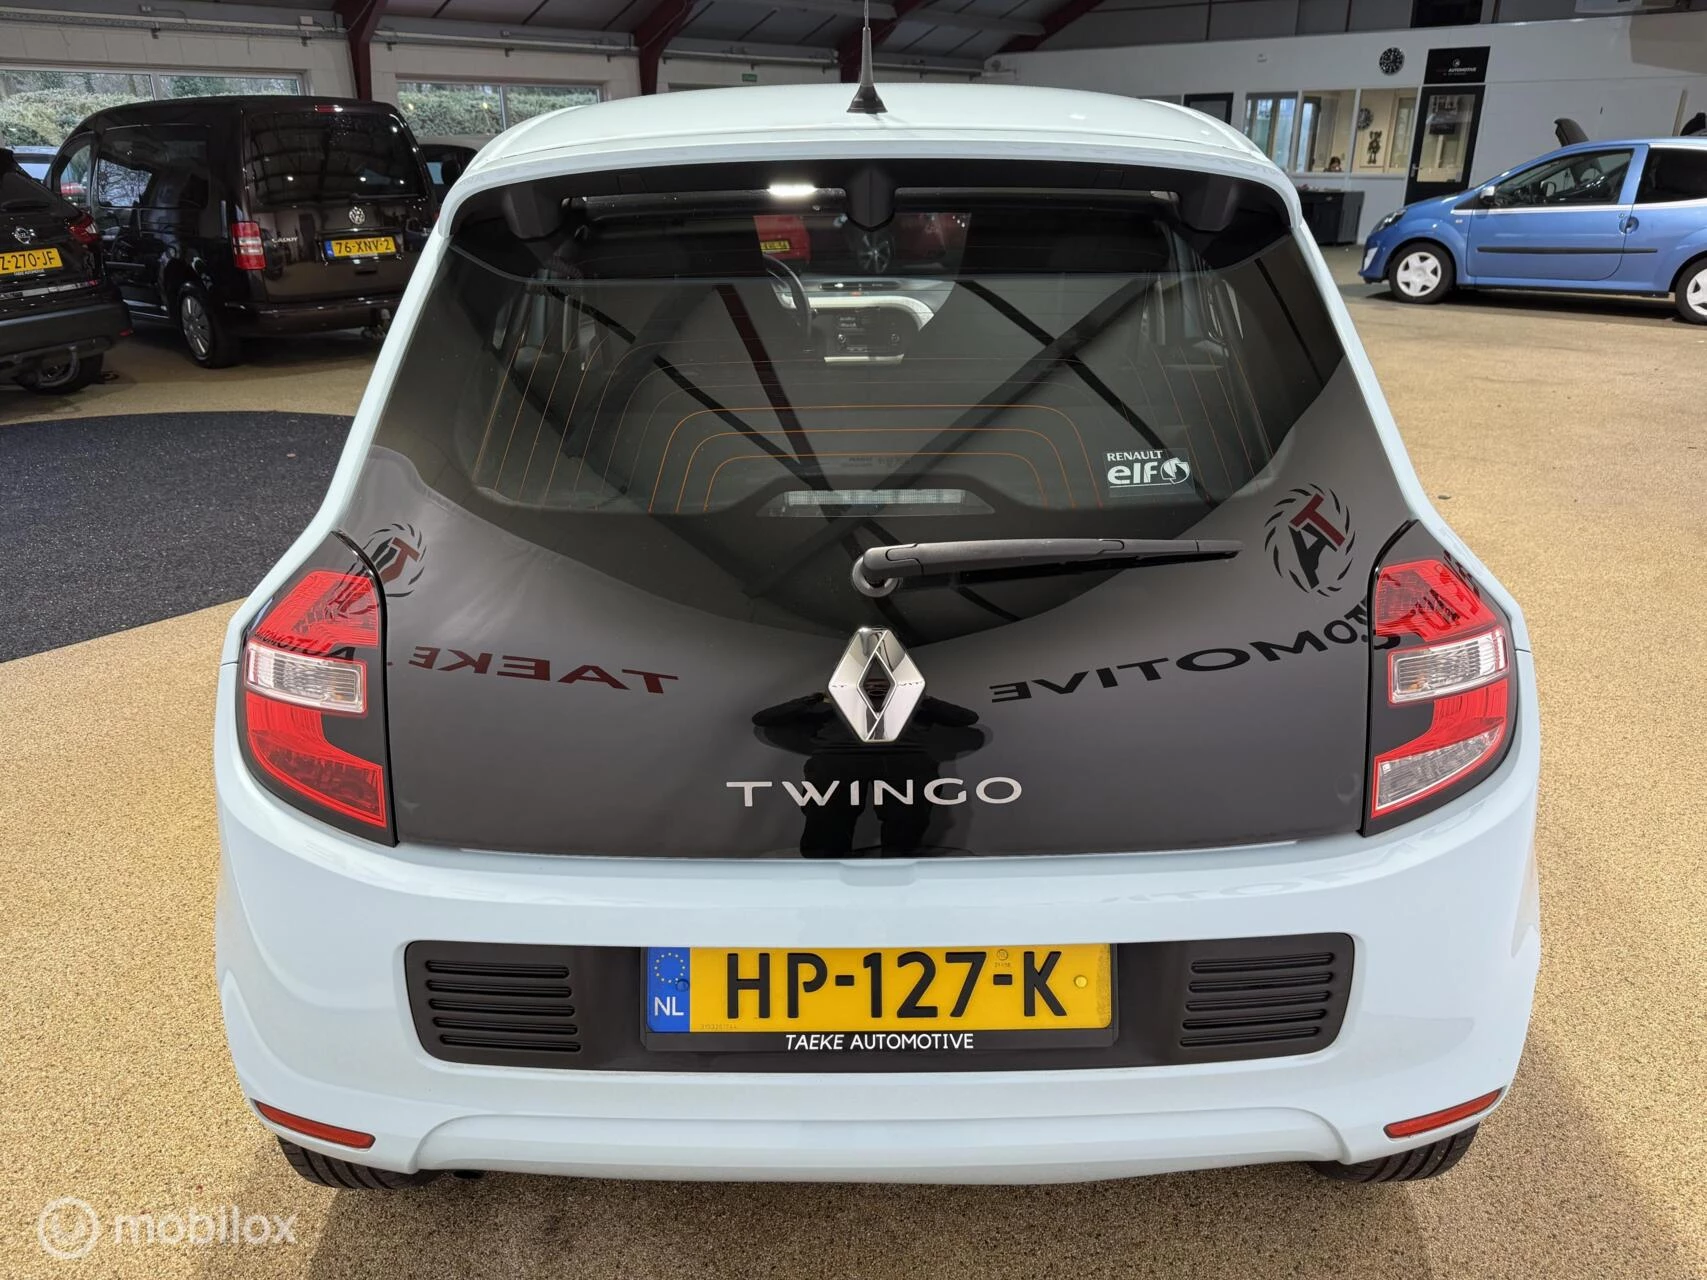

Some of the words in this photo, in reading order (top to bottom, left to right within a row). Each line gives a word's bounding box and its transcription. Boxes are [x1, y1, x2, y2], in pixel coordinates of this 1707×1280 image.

[335, 239, 391, 254] 76-XNV-2
[1107, 450, 1163, 461] RENAULT
[1107, 461, 1158, 484] elf
[726, 776, 1023, 807] TWINGO
[727, 951, 1068, 1019] HP-127-K
[654, 996, 685, 1016] NL
[786, 1034, 844, 1050] TAEKE
[850, 1033, 974, 1050] AUTOMOTIVE
